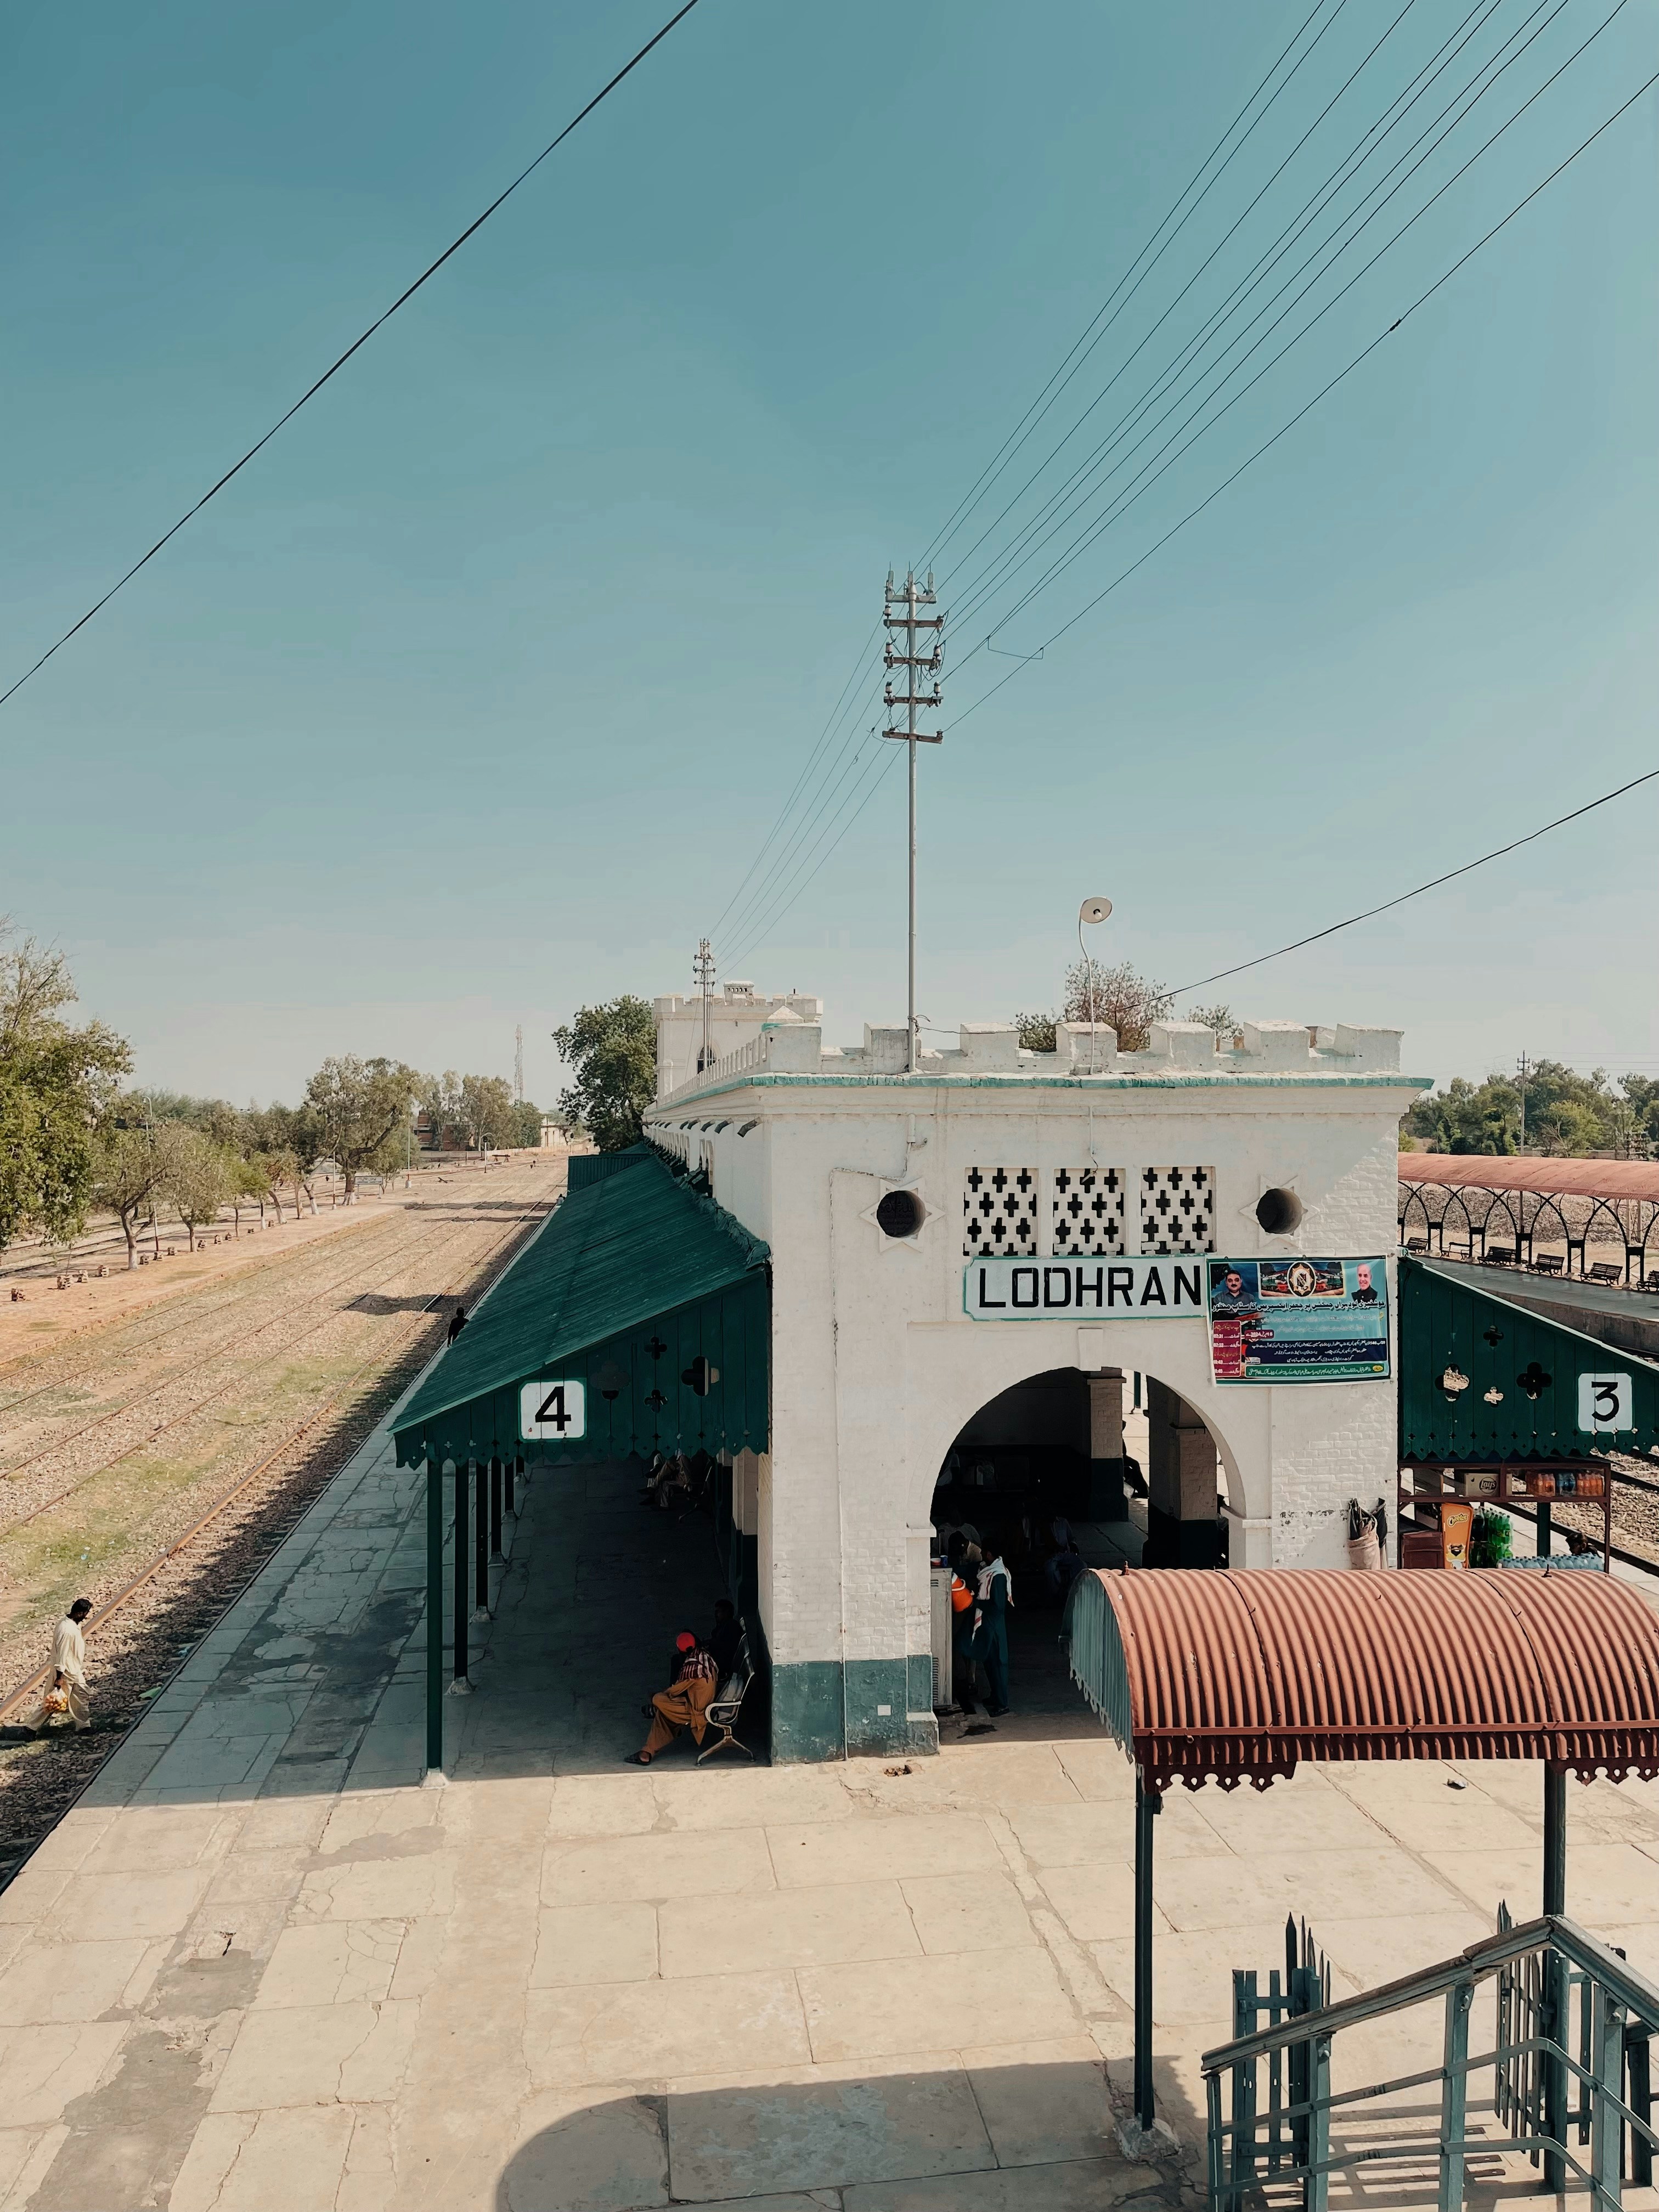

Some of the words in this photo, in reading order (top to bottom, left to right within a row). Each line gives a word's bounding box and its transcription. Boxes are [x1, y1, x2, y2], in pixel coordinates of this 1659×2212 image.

[979, 1265, 1201, 1308] LODHRAN
[535, 1386, 571, 1431] 4
[1591, 1381, 1620, 1422] 3
[1448, 1514, 1468, 1526] Cheetos
